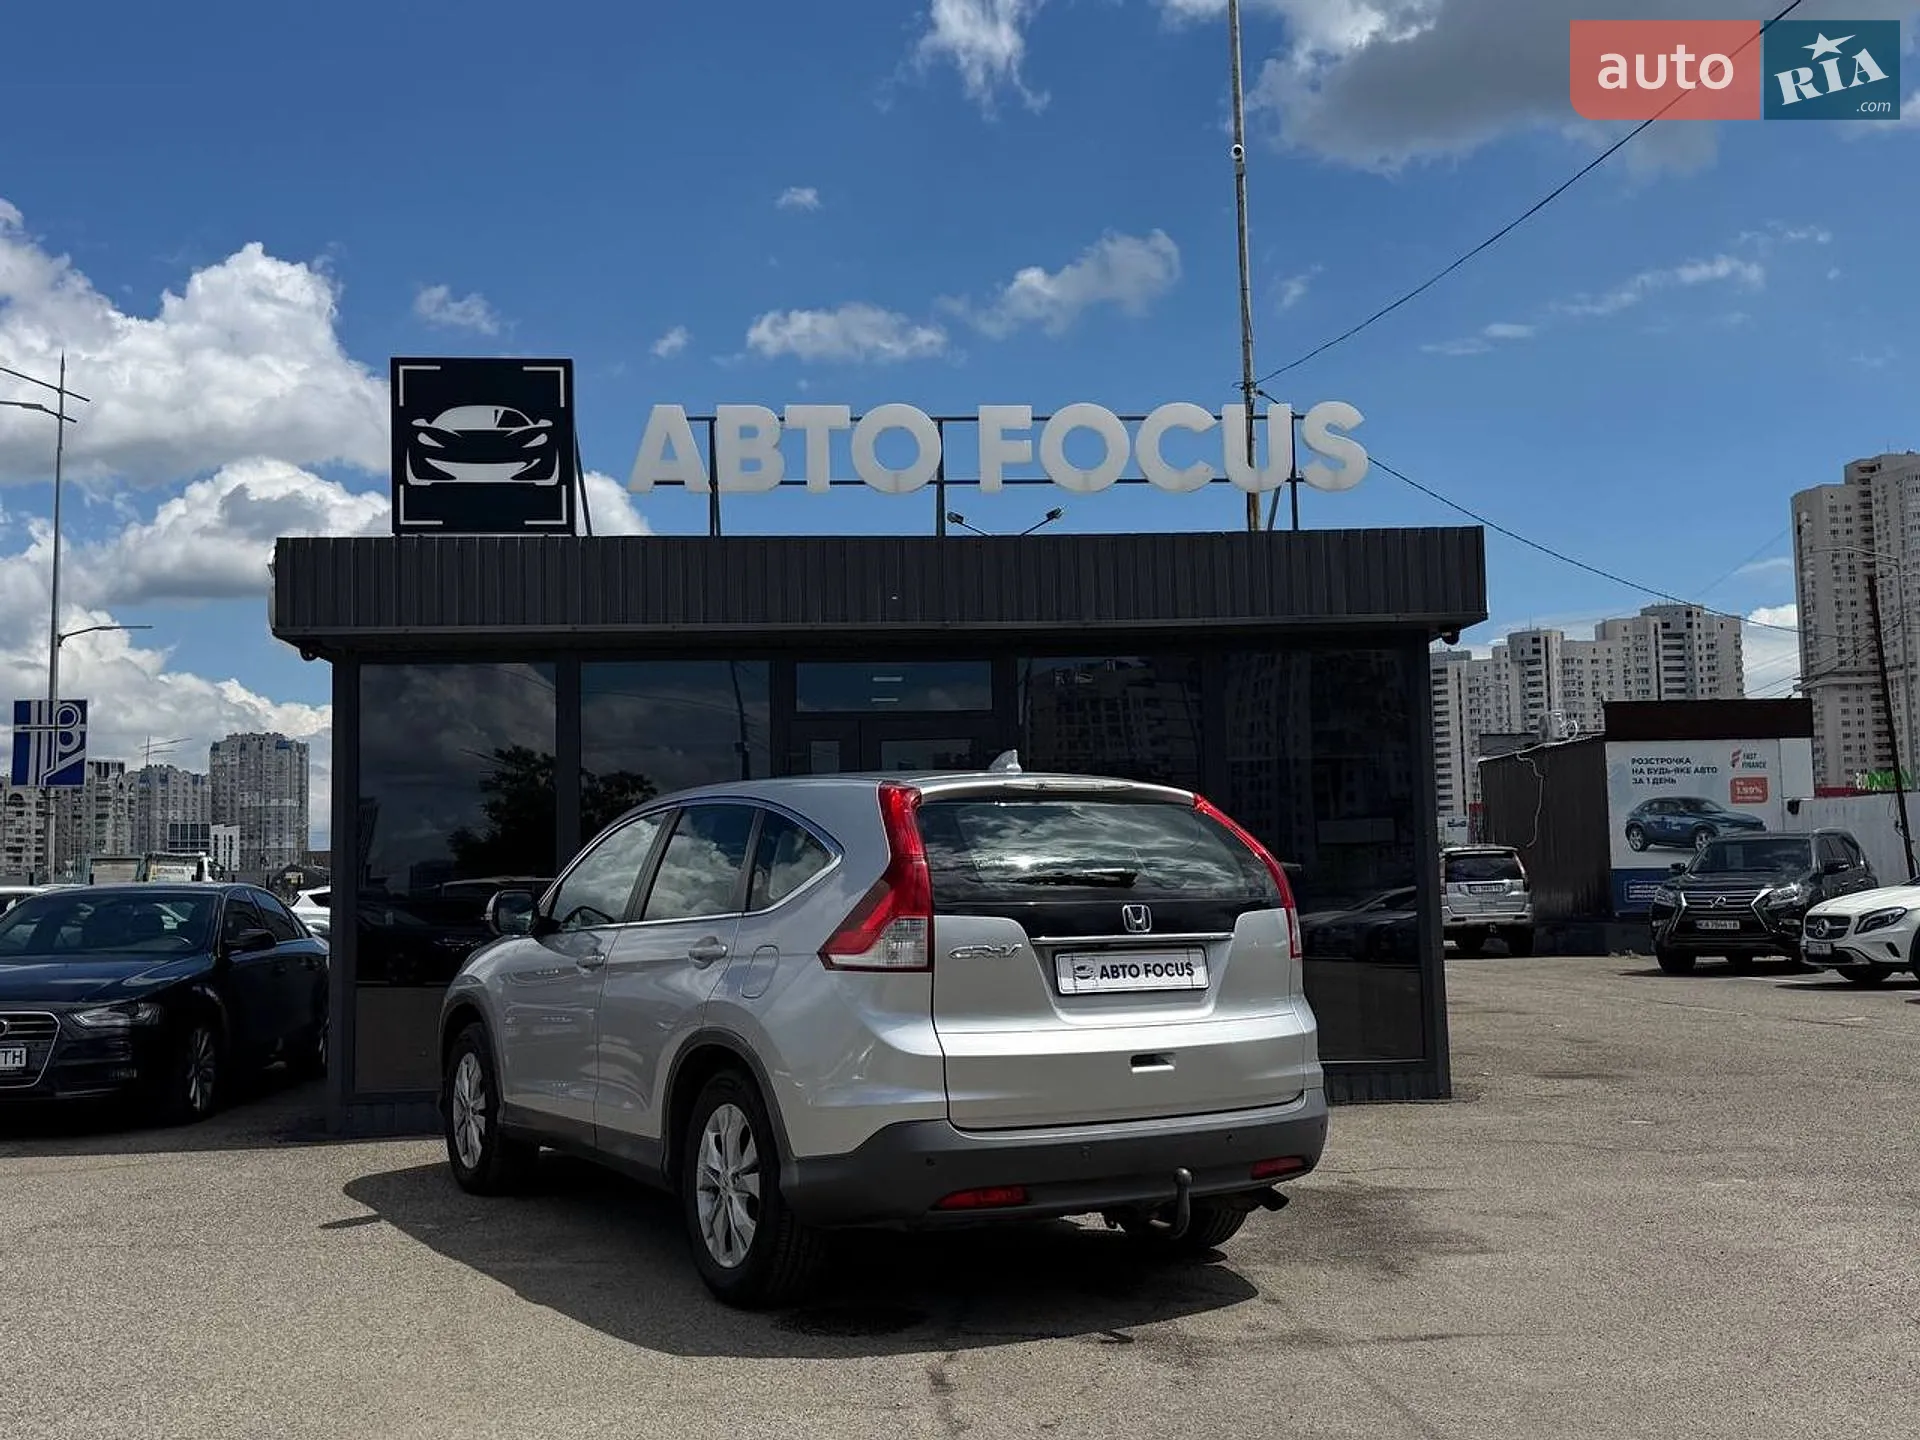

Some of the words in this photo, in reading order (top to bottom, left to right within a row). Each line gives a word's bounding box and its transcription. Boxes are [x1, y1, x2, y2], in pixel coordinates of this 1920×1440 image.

[628, 402, 942, 494] АВТО
[977, 402, 1369, 494] FOCUS
[1632, 767, 1646, 775] НА
[1693, 766, 1718, 774] АВТО
[1652, 777, 1677, 786] ДЕНЬ
[1099, 962, 1141, 980] АВТО
[1144, 961, 1195, 978] FOCUS
